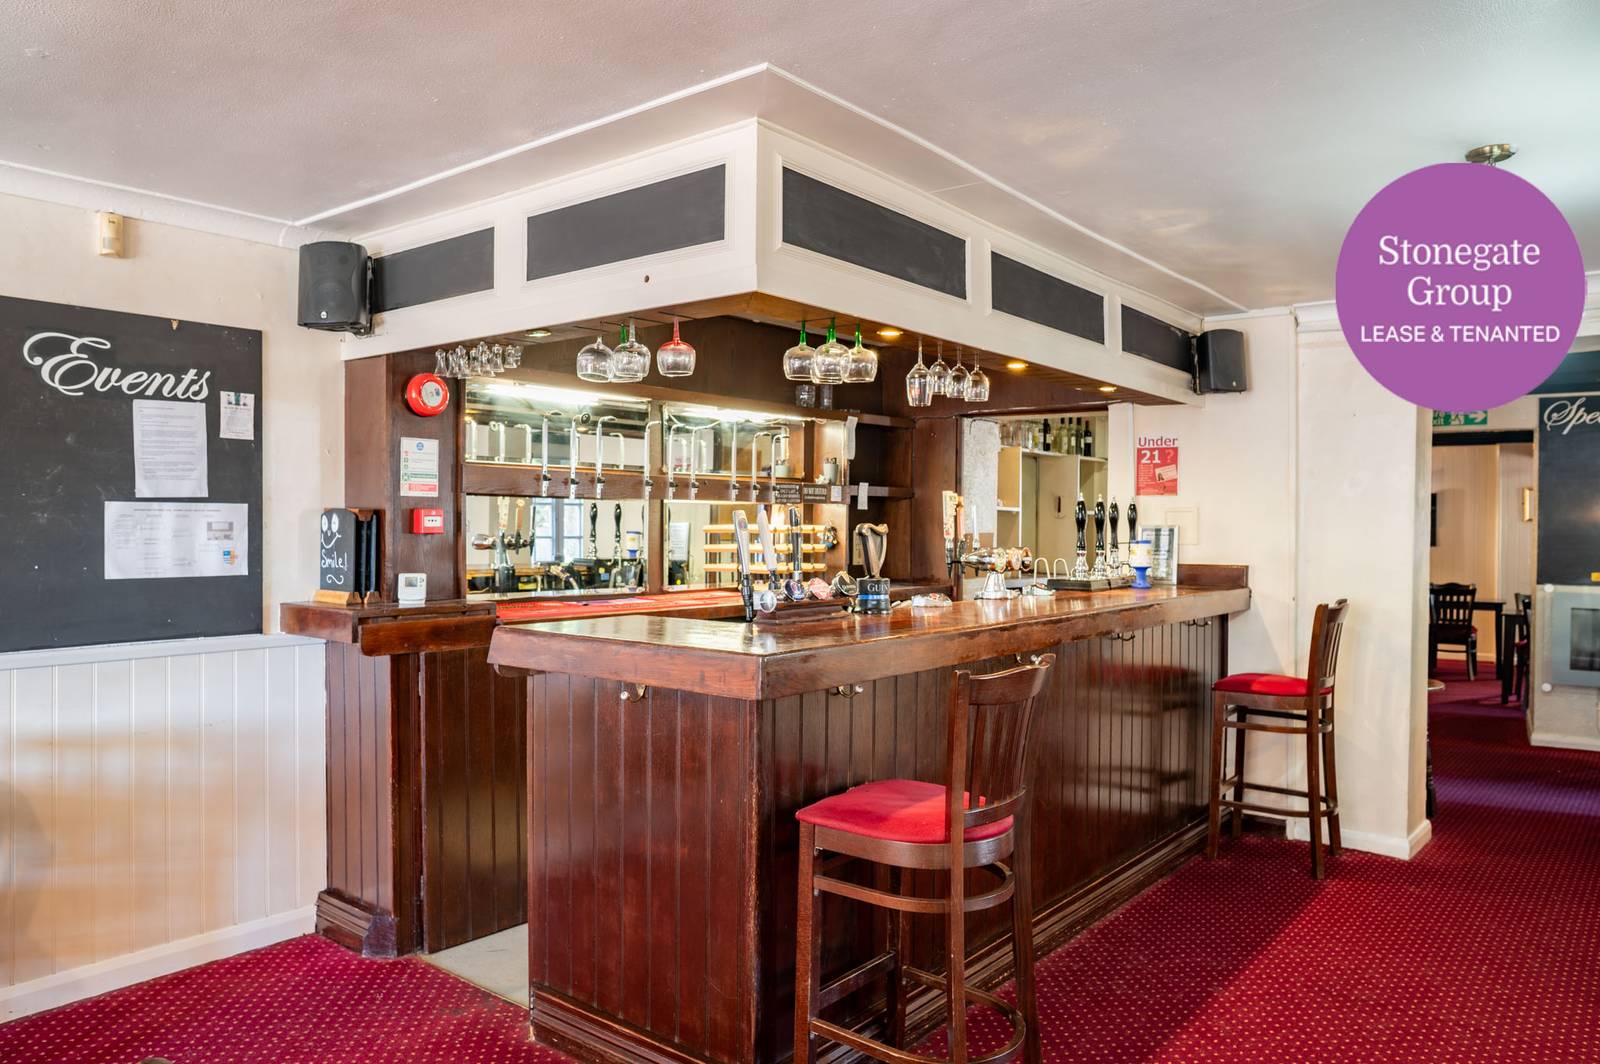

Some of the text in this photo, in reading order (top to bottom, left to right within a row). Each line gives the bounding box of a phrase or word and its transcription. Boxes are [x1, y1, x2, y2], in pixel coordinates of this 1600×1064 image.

[23, 332, 211, 401] Events
[1543, 397, 1600, 436] Spe
[1138, 436, 1178, 447] Under
[1141, 449, 1161, 464] 21
[321, 548, 348, 571] Smile!
